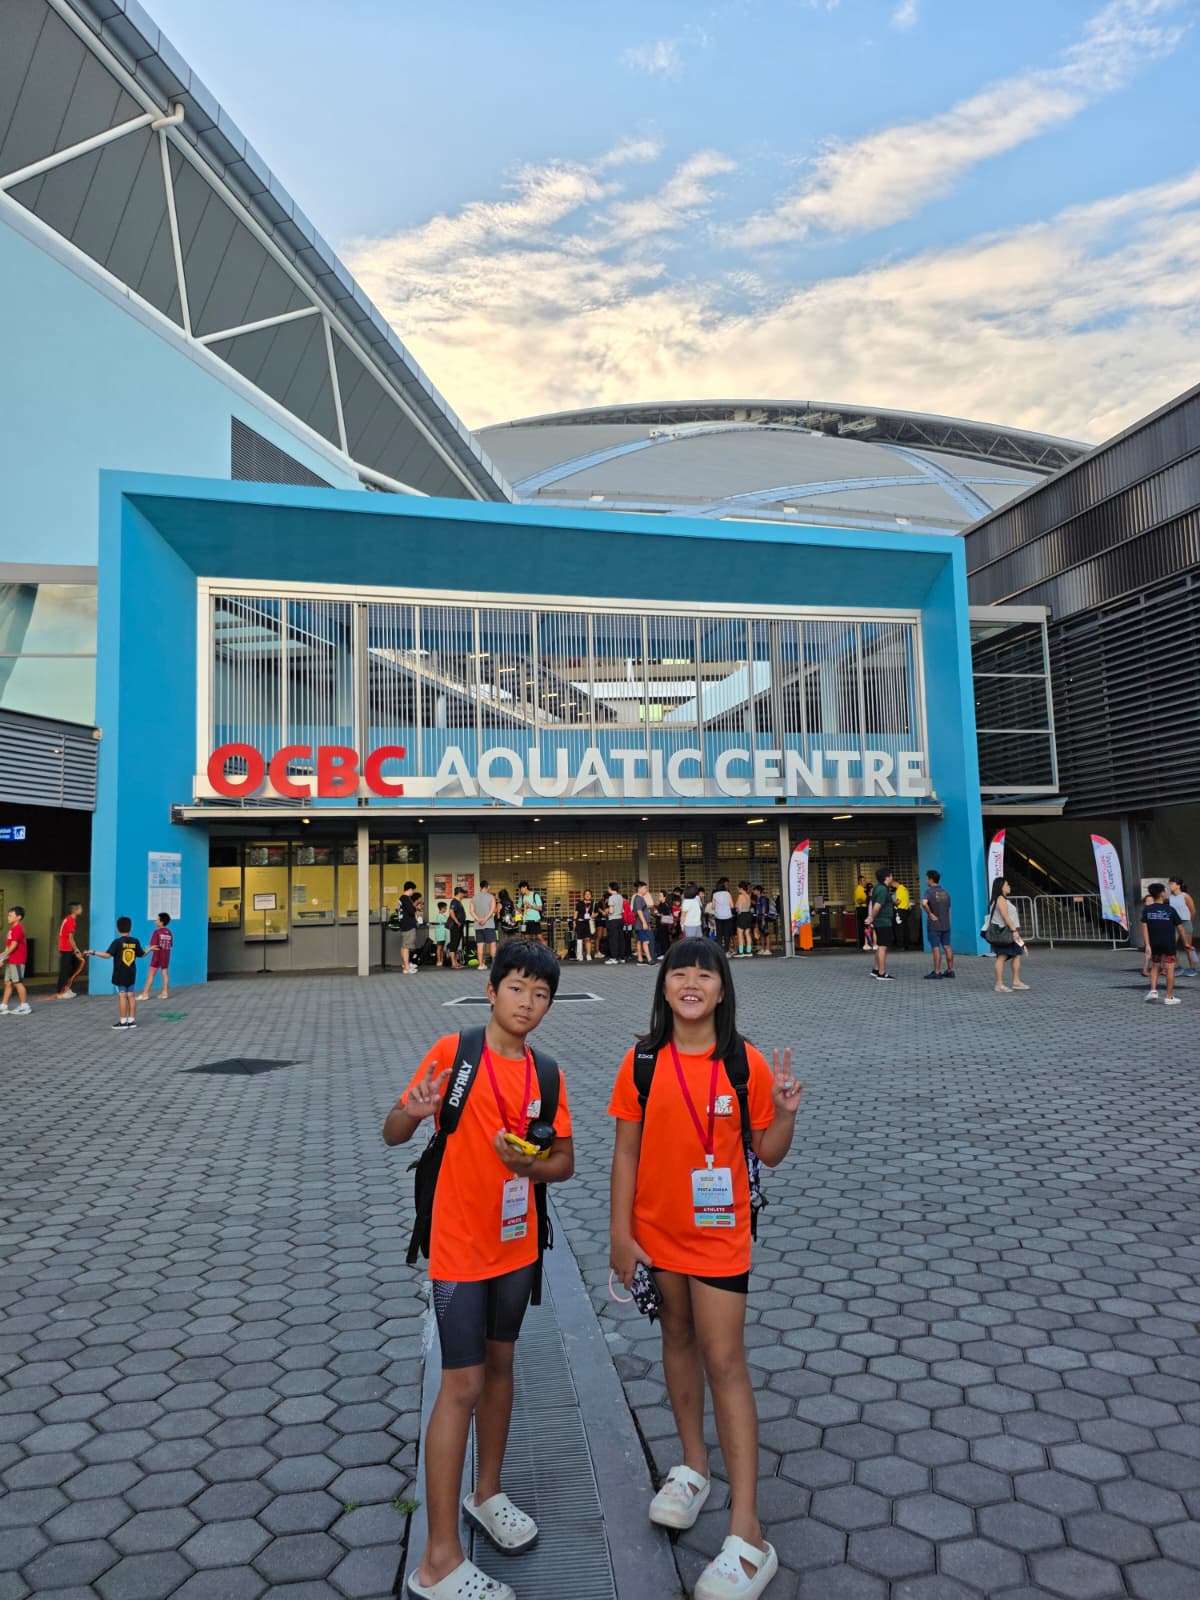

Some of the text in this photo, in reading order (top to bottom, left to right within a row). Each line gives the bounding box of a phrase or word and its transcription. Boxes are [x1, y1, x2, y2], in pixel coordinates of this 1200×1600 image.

[207, 743, 926, 807] OCBC AQUATIC CENTRE
[449, 1059, 472, 1107] DUFAILY
